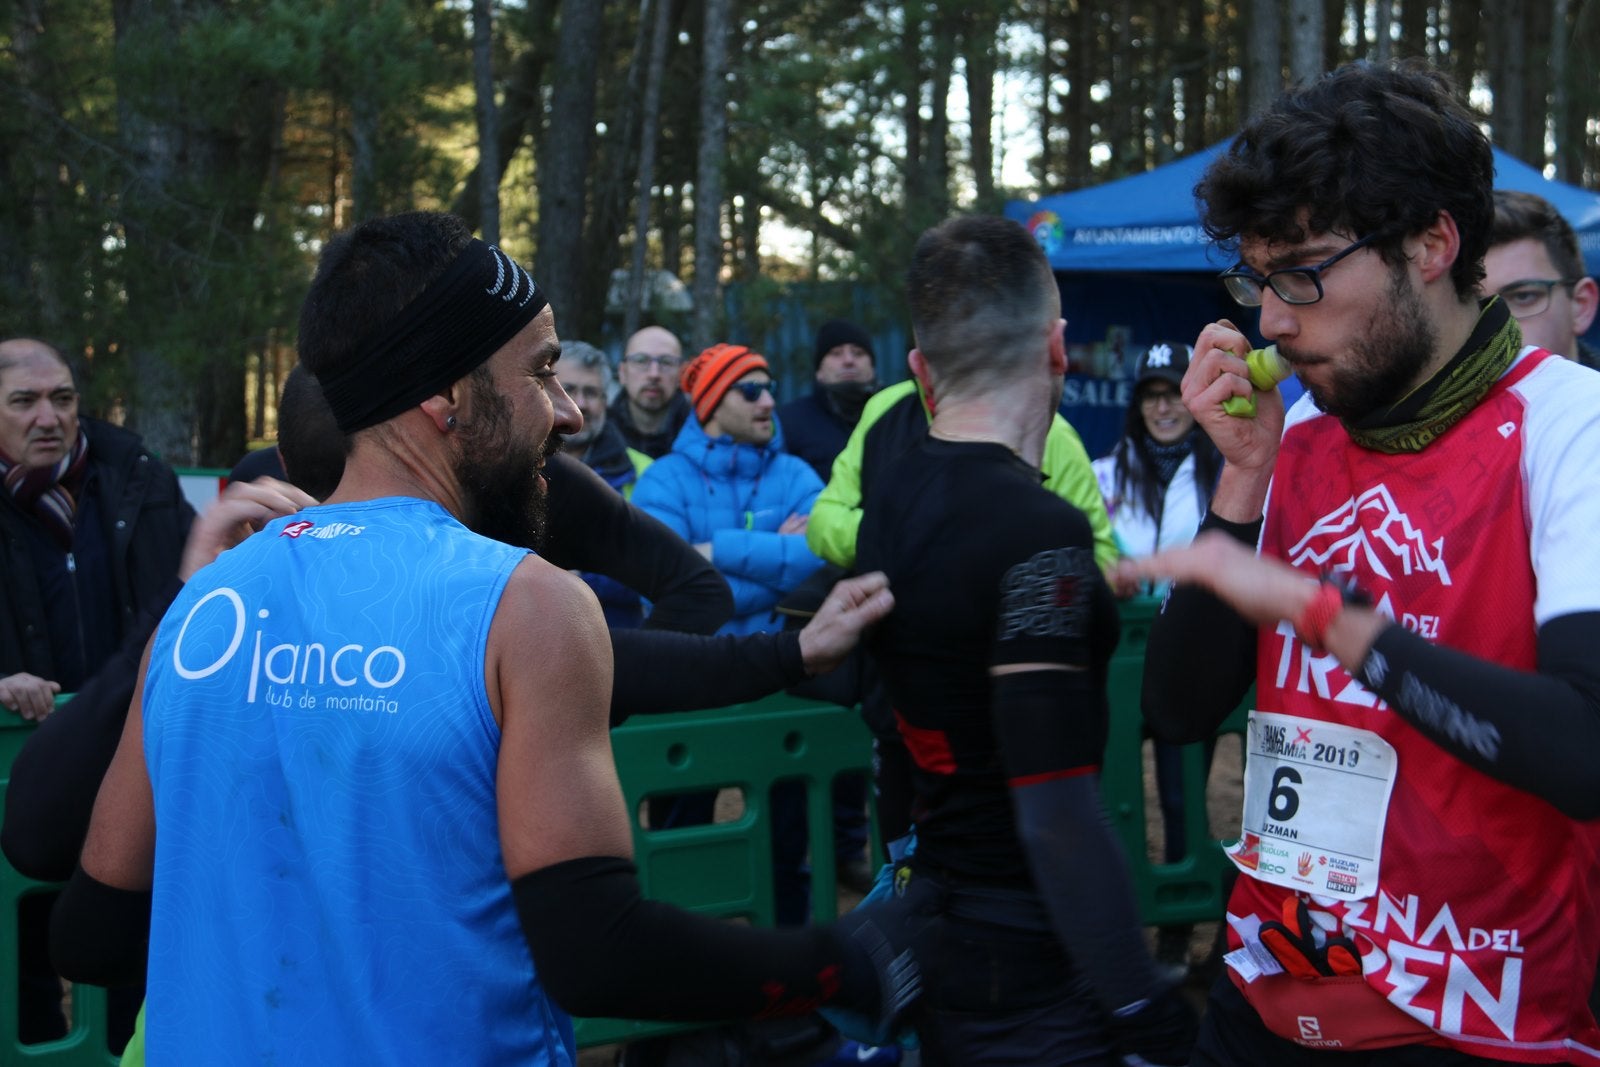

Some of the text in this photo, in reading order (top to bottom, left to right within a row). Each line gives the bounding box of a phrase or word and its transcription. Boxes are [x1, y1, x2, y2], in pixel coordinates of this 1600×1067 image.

[1074, 226, 1195, 245] AYUNTAMIENTO
[1402, 612, 1440, 639] DEL
[173, 586, 406, 703] Ojanco
[299, 689, 316, 709] de
[326, 695, 398, 713] montaña
[1313, 743, 1360, 768] 2019
[1268, 765, 1303, 822] 6
[1329, 857, 1359, 869] SUZUKI
[1468, 927, 1524, 953] DEL
